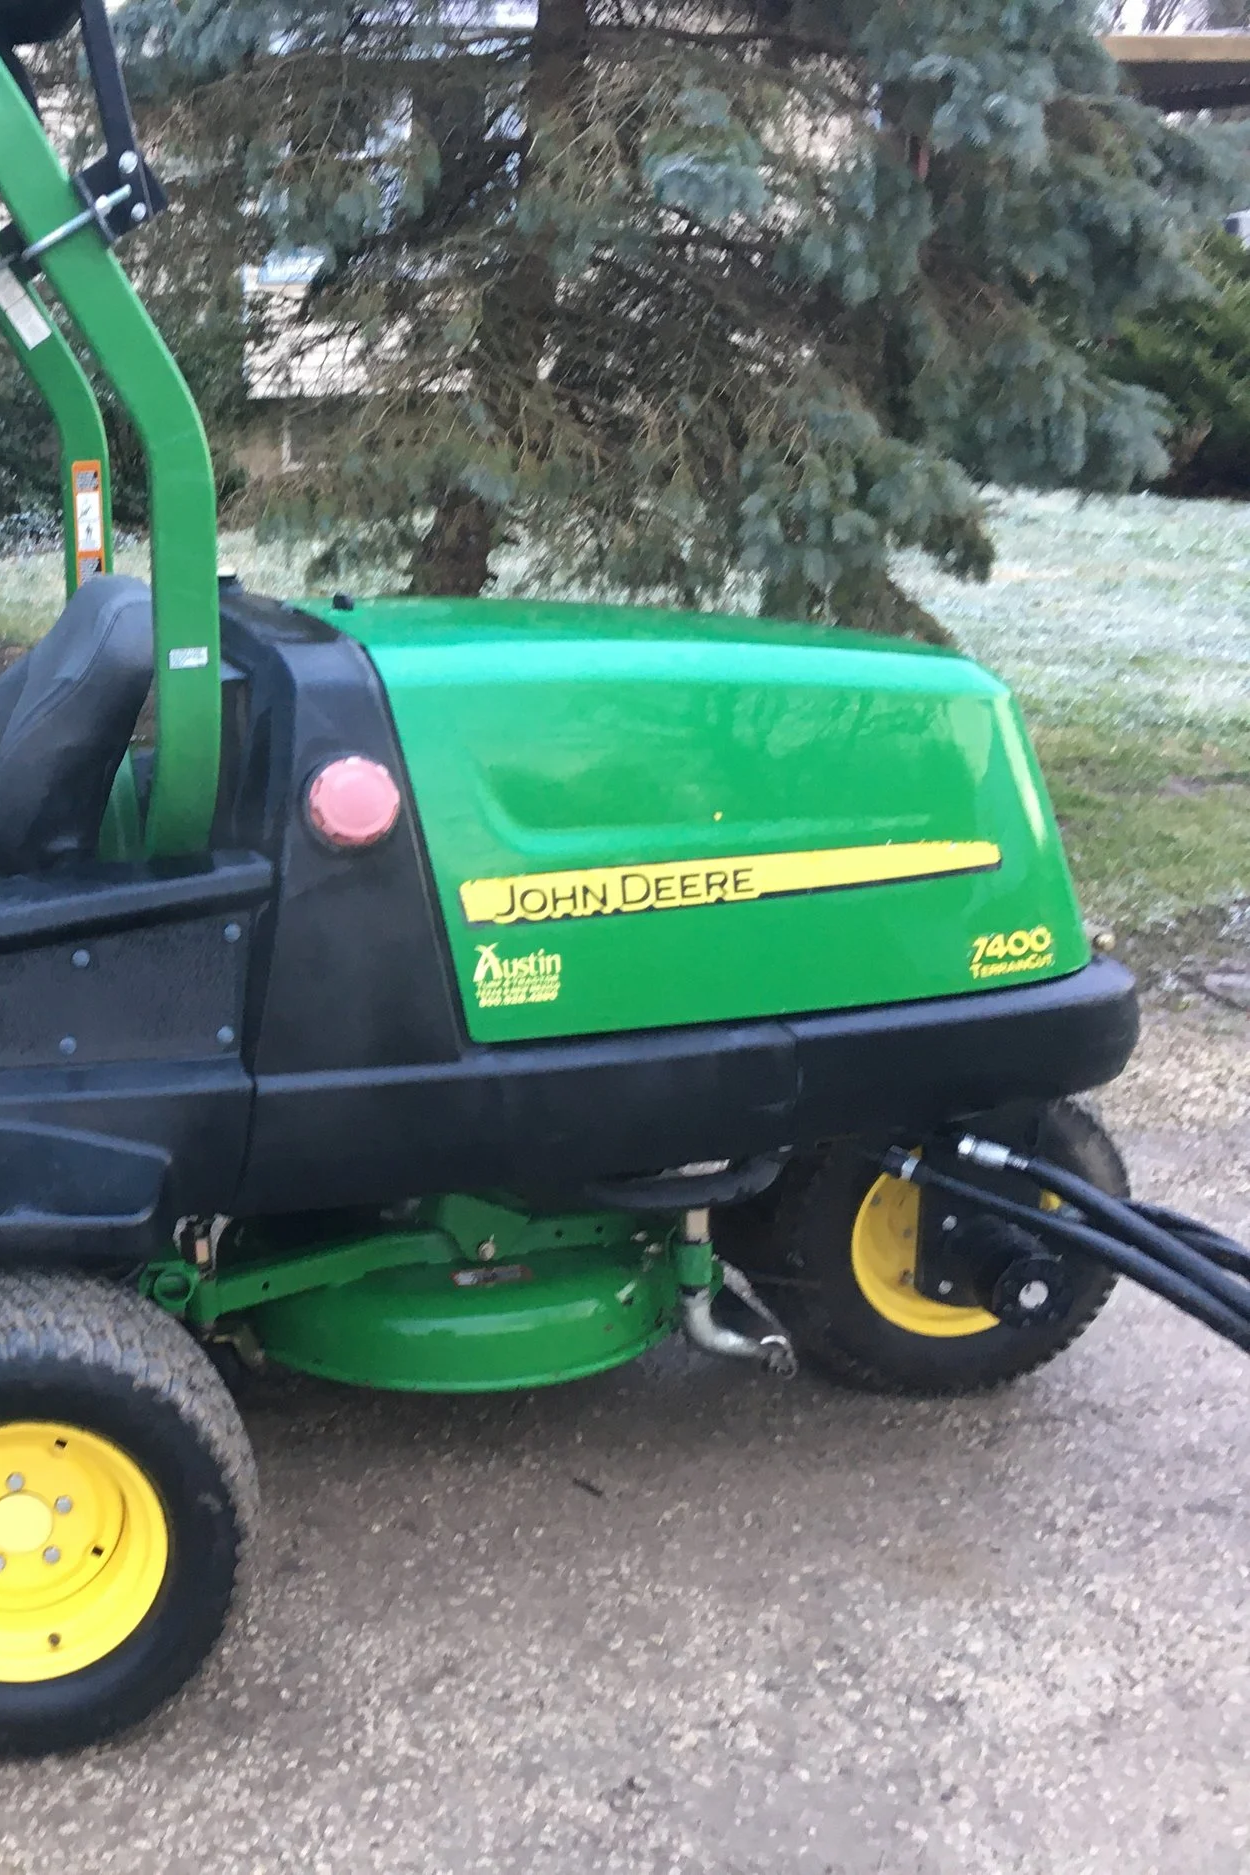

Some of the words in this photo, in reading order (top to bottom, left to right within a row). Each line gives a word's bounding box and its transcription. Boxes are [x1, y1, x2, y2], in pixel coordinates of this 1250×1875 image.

[495, 882, 607, 916] JOHN
[620, 867, 755, 905] DEERE
[473, 941, 562, 982] Austin
[970, 926, 1052, 965] 7400
